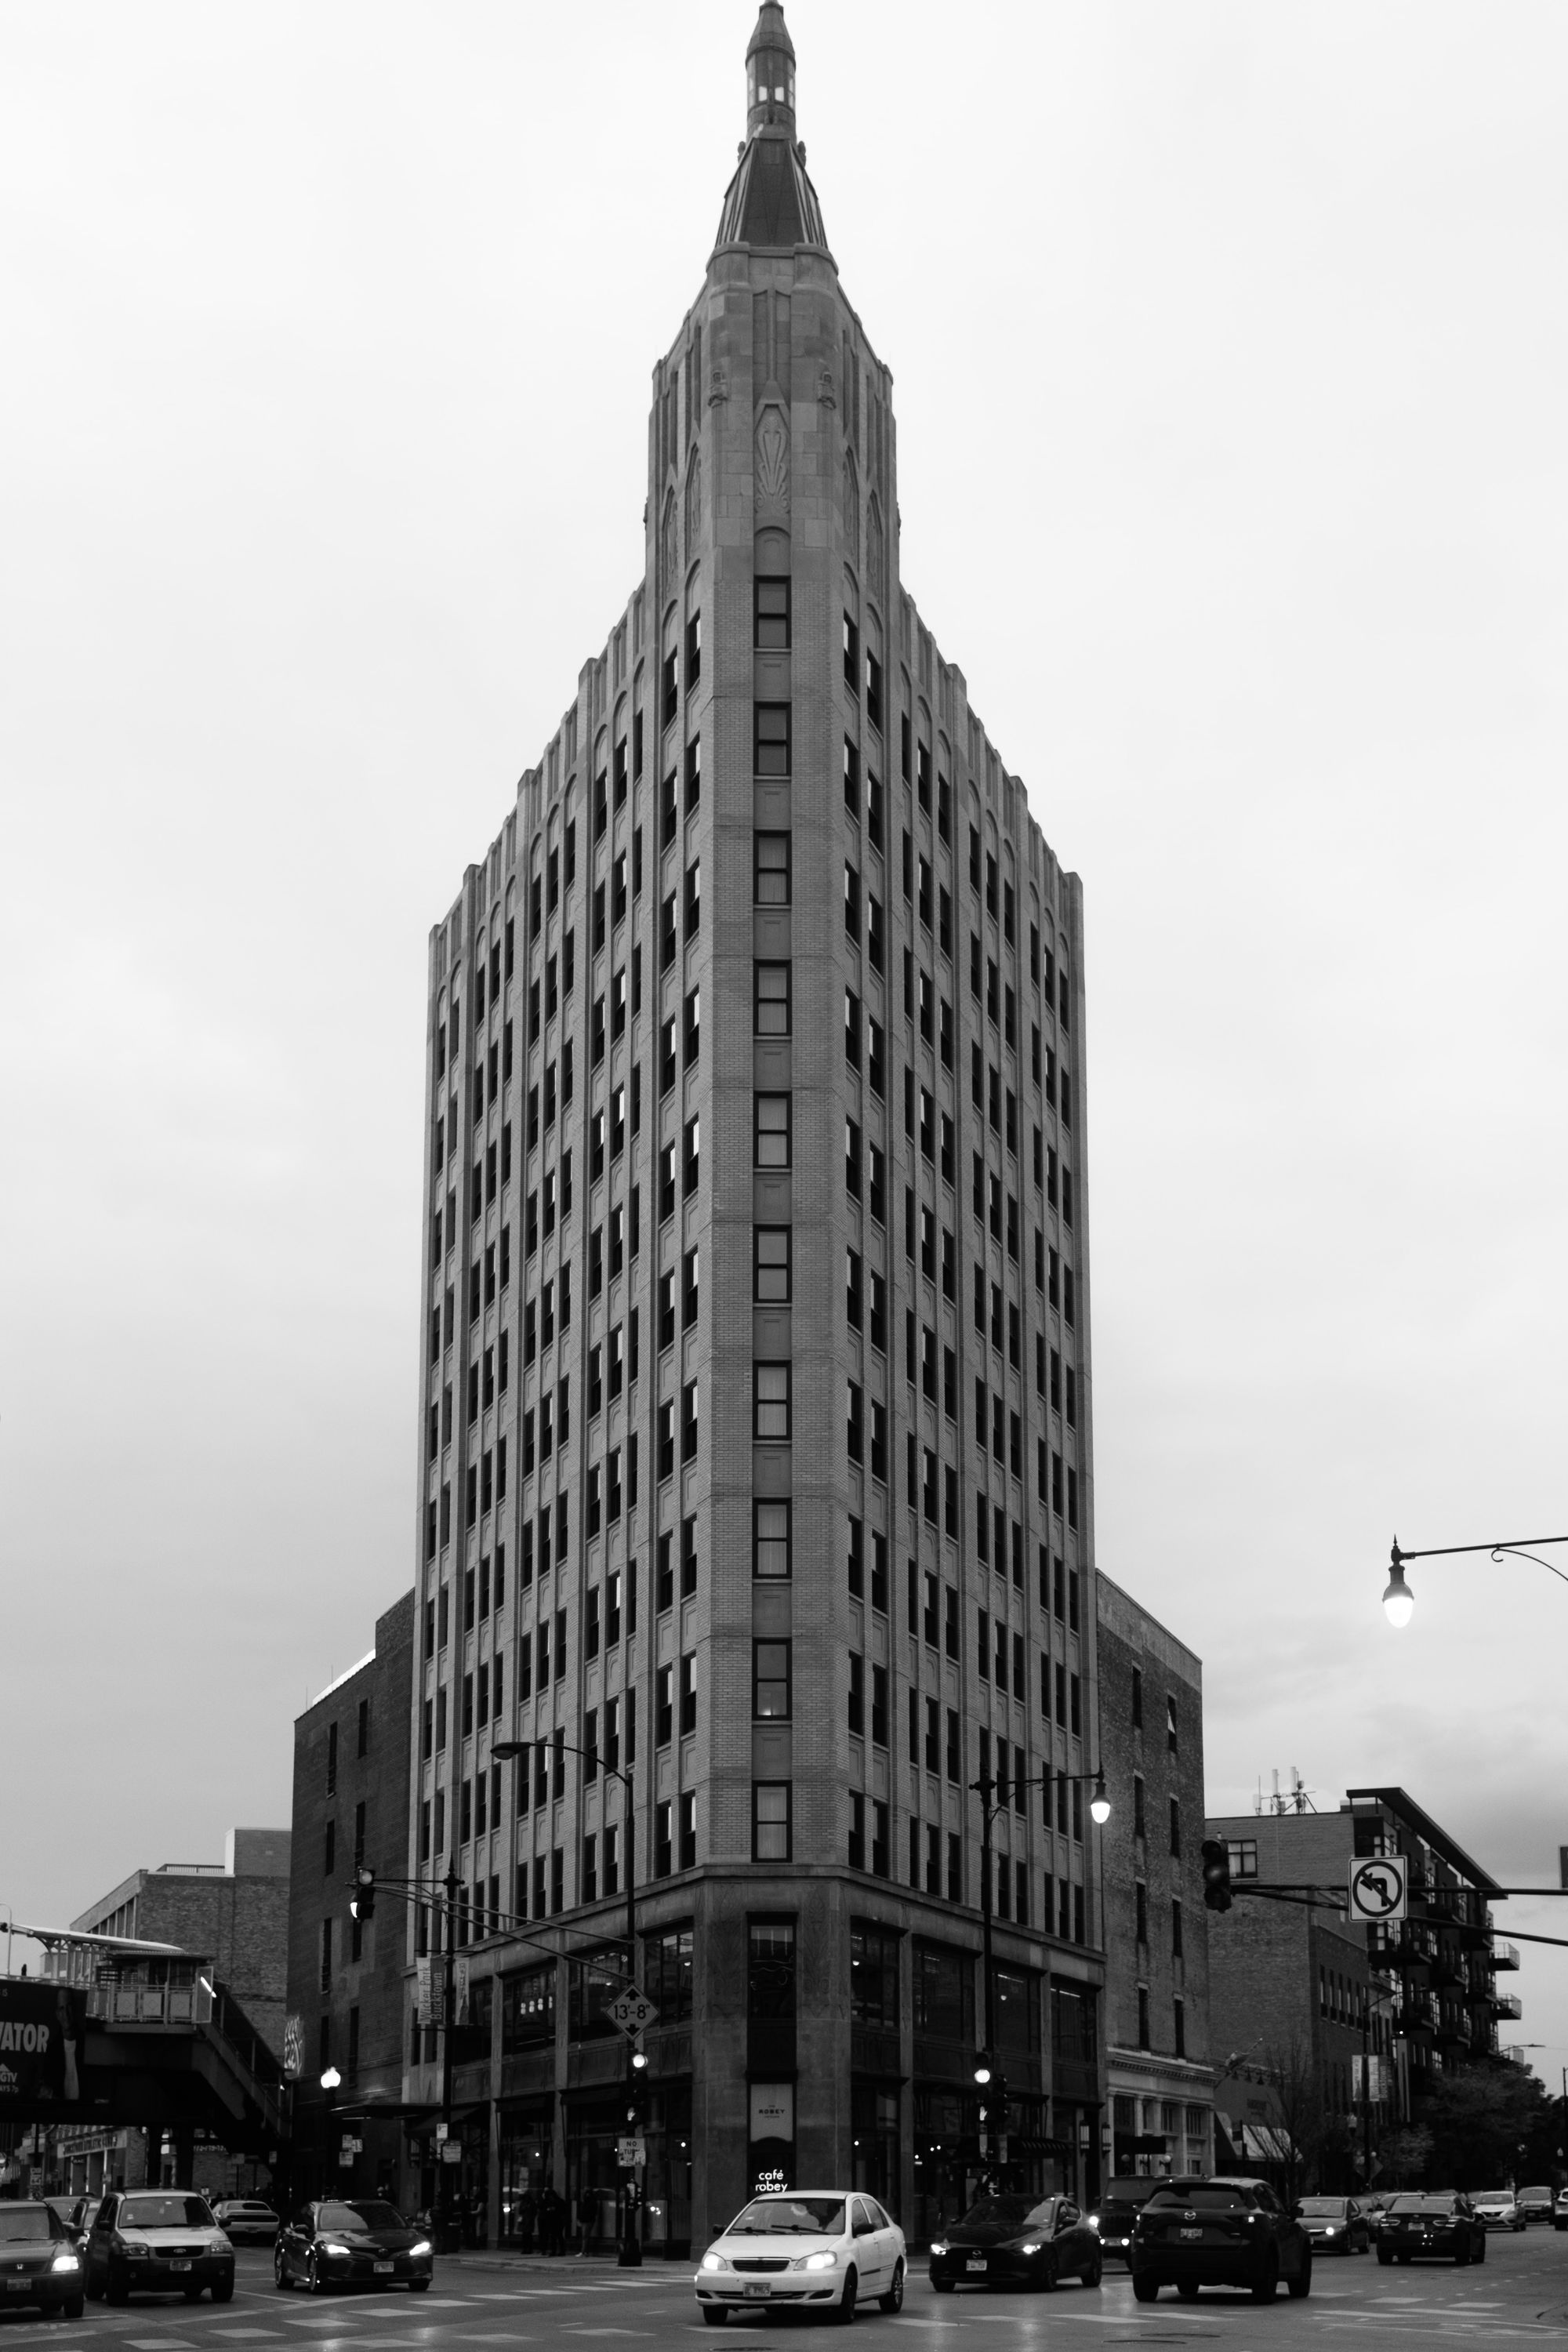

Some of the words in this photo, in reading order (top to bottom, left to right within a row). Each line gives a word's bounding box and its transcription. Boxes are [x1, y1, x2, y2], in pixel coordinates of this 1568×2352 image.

[419, 1965, 430, 1986] Park
[420, 1990, 431, 2021] Wicker
[431, 1972, 443, 2020] Bucktown
[758, 2169, 784, 2180] café
[755, 2180, 788, 2193] robey
